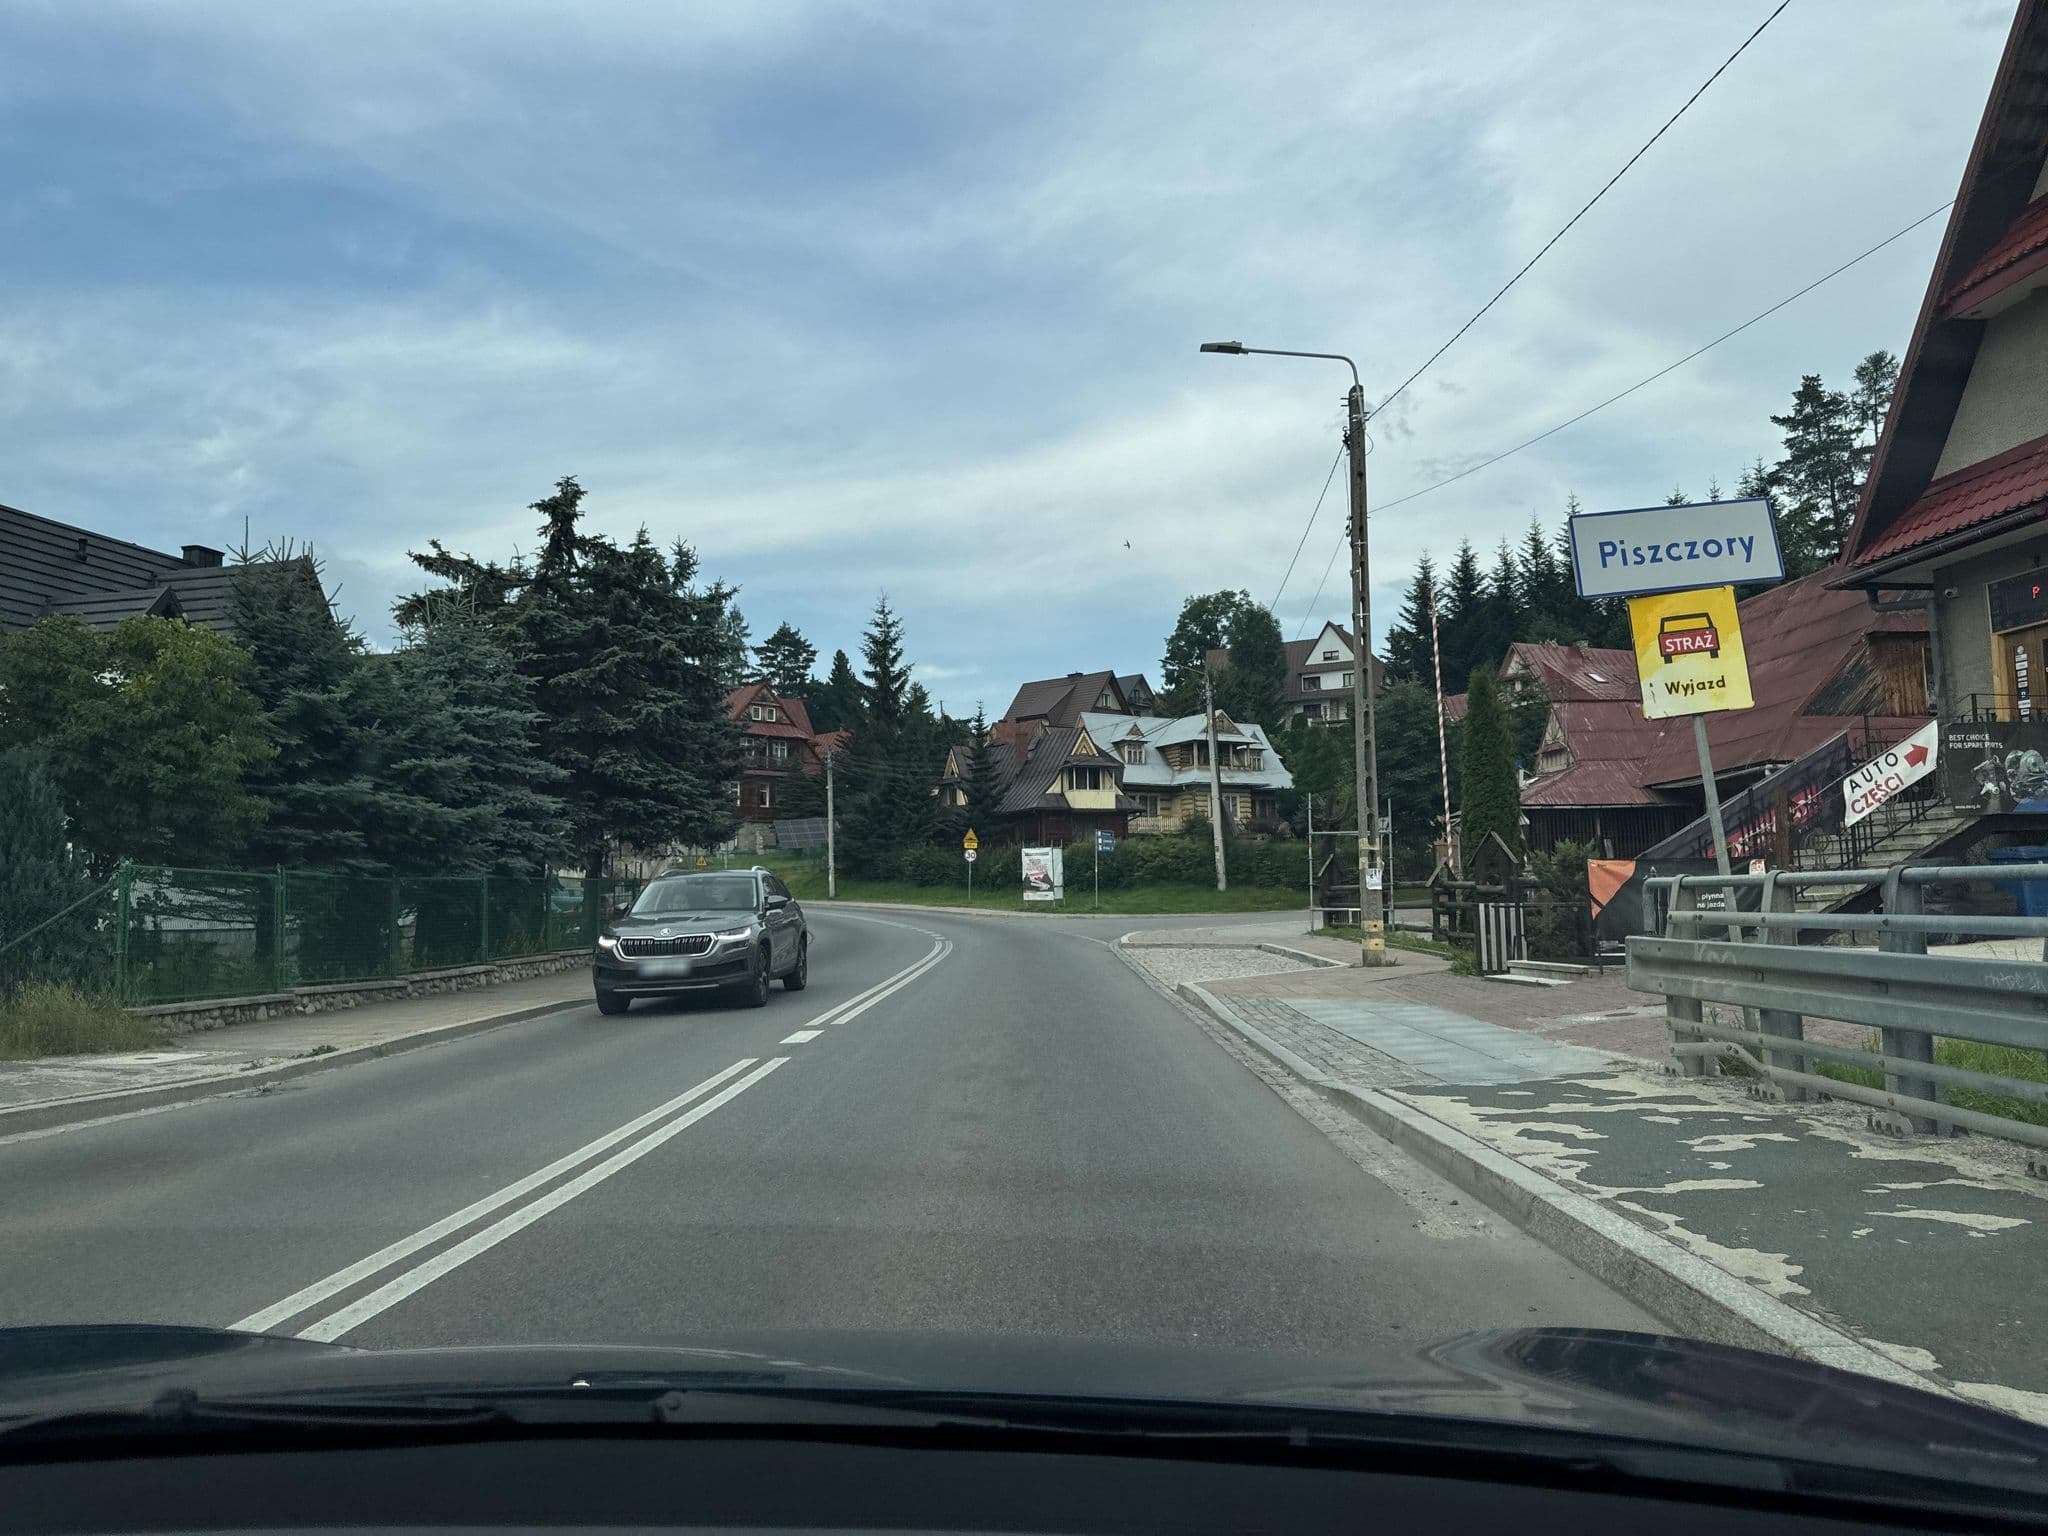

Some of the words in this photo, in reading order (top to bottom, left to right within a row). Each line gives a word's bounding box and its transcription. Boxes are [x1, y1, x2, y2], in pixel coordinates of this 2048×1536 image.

[1598, 536, 1754, 568] Piszczory
[1665, 631, 1714, 652] STRAŻ
[1664, 675, 1726, 697] Wyjazd
[1948, 734, 1965, 742] BEST
[1965, 733, 1990, 742] CHOICE
[1849, 751, 1898, 795] AUTO
[1850, 771, 1904, 815] CZĘŚCI
[966, 851, 976, 859] 30
